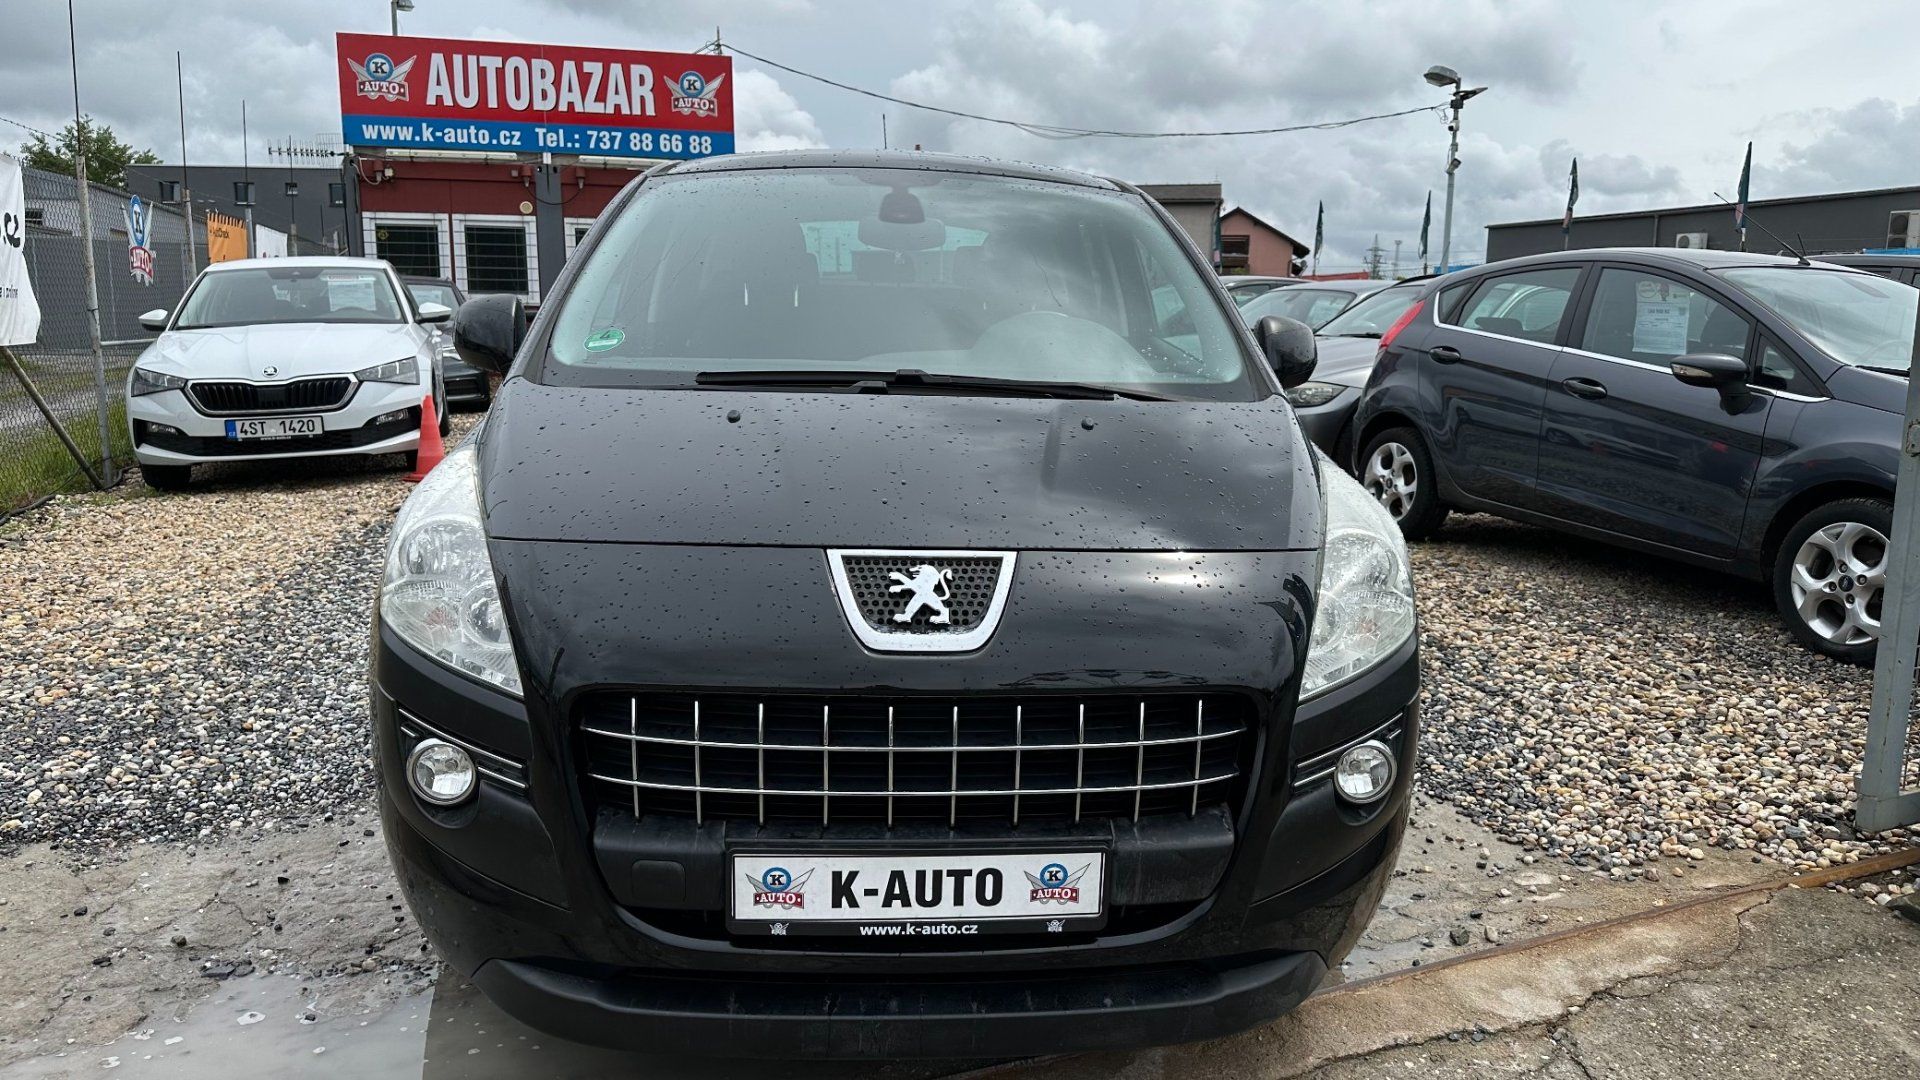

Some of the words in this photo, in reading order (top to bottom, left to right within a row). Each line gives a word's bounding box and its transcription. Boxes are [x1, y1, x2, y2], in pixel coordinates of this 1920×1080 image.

[371, 61, 388, 74] K
[364, 81, 399, 95] AUTO
[426, 53, 656, 116] AUTOBAZAR
[685, 79, 700, 91] K
[677, 97, 710, 111] AUTO
[362, 123, 521, 146] www.k-auto.cz
[535, 127, 580, 148] Tel.:
[587, 130, 622, 150] 737
[629, 132, 653, 152] 88
[659, 133, 683, 153] 66
[689, 135, 712, 155] 88
[240, 420, 267, 436] 4ST
[279, 419, 316, 434] 1420
[769, 874, 785, 886] K
[1046, 870, 1062, 882] K
[831, 867, 1003, 909] K-AUTO
[1036, 888, 1071, 899] AUTO
[759, 893, 796, 904] AUTO
[859, 922, 978, 936] www.k-auto.cz
